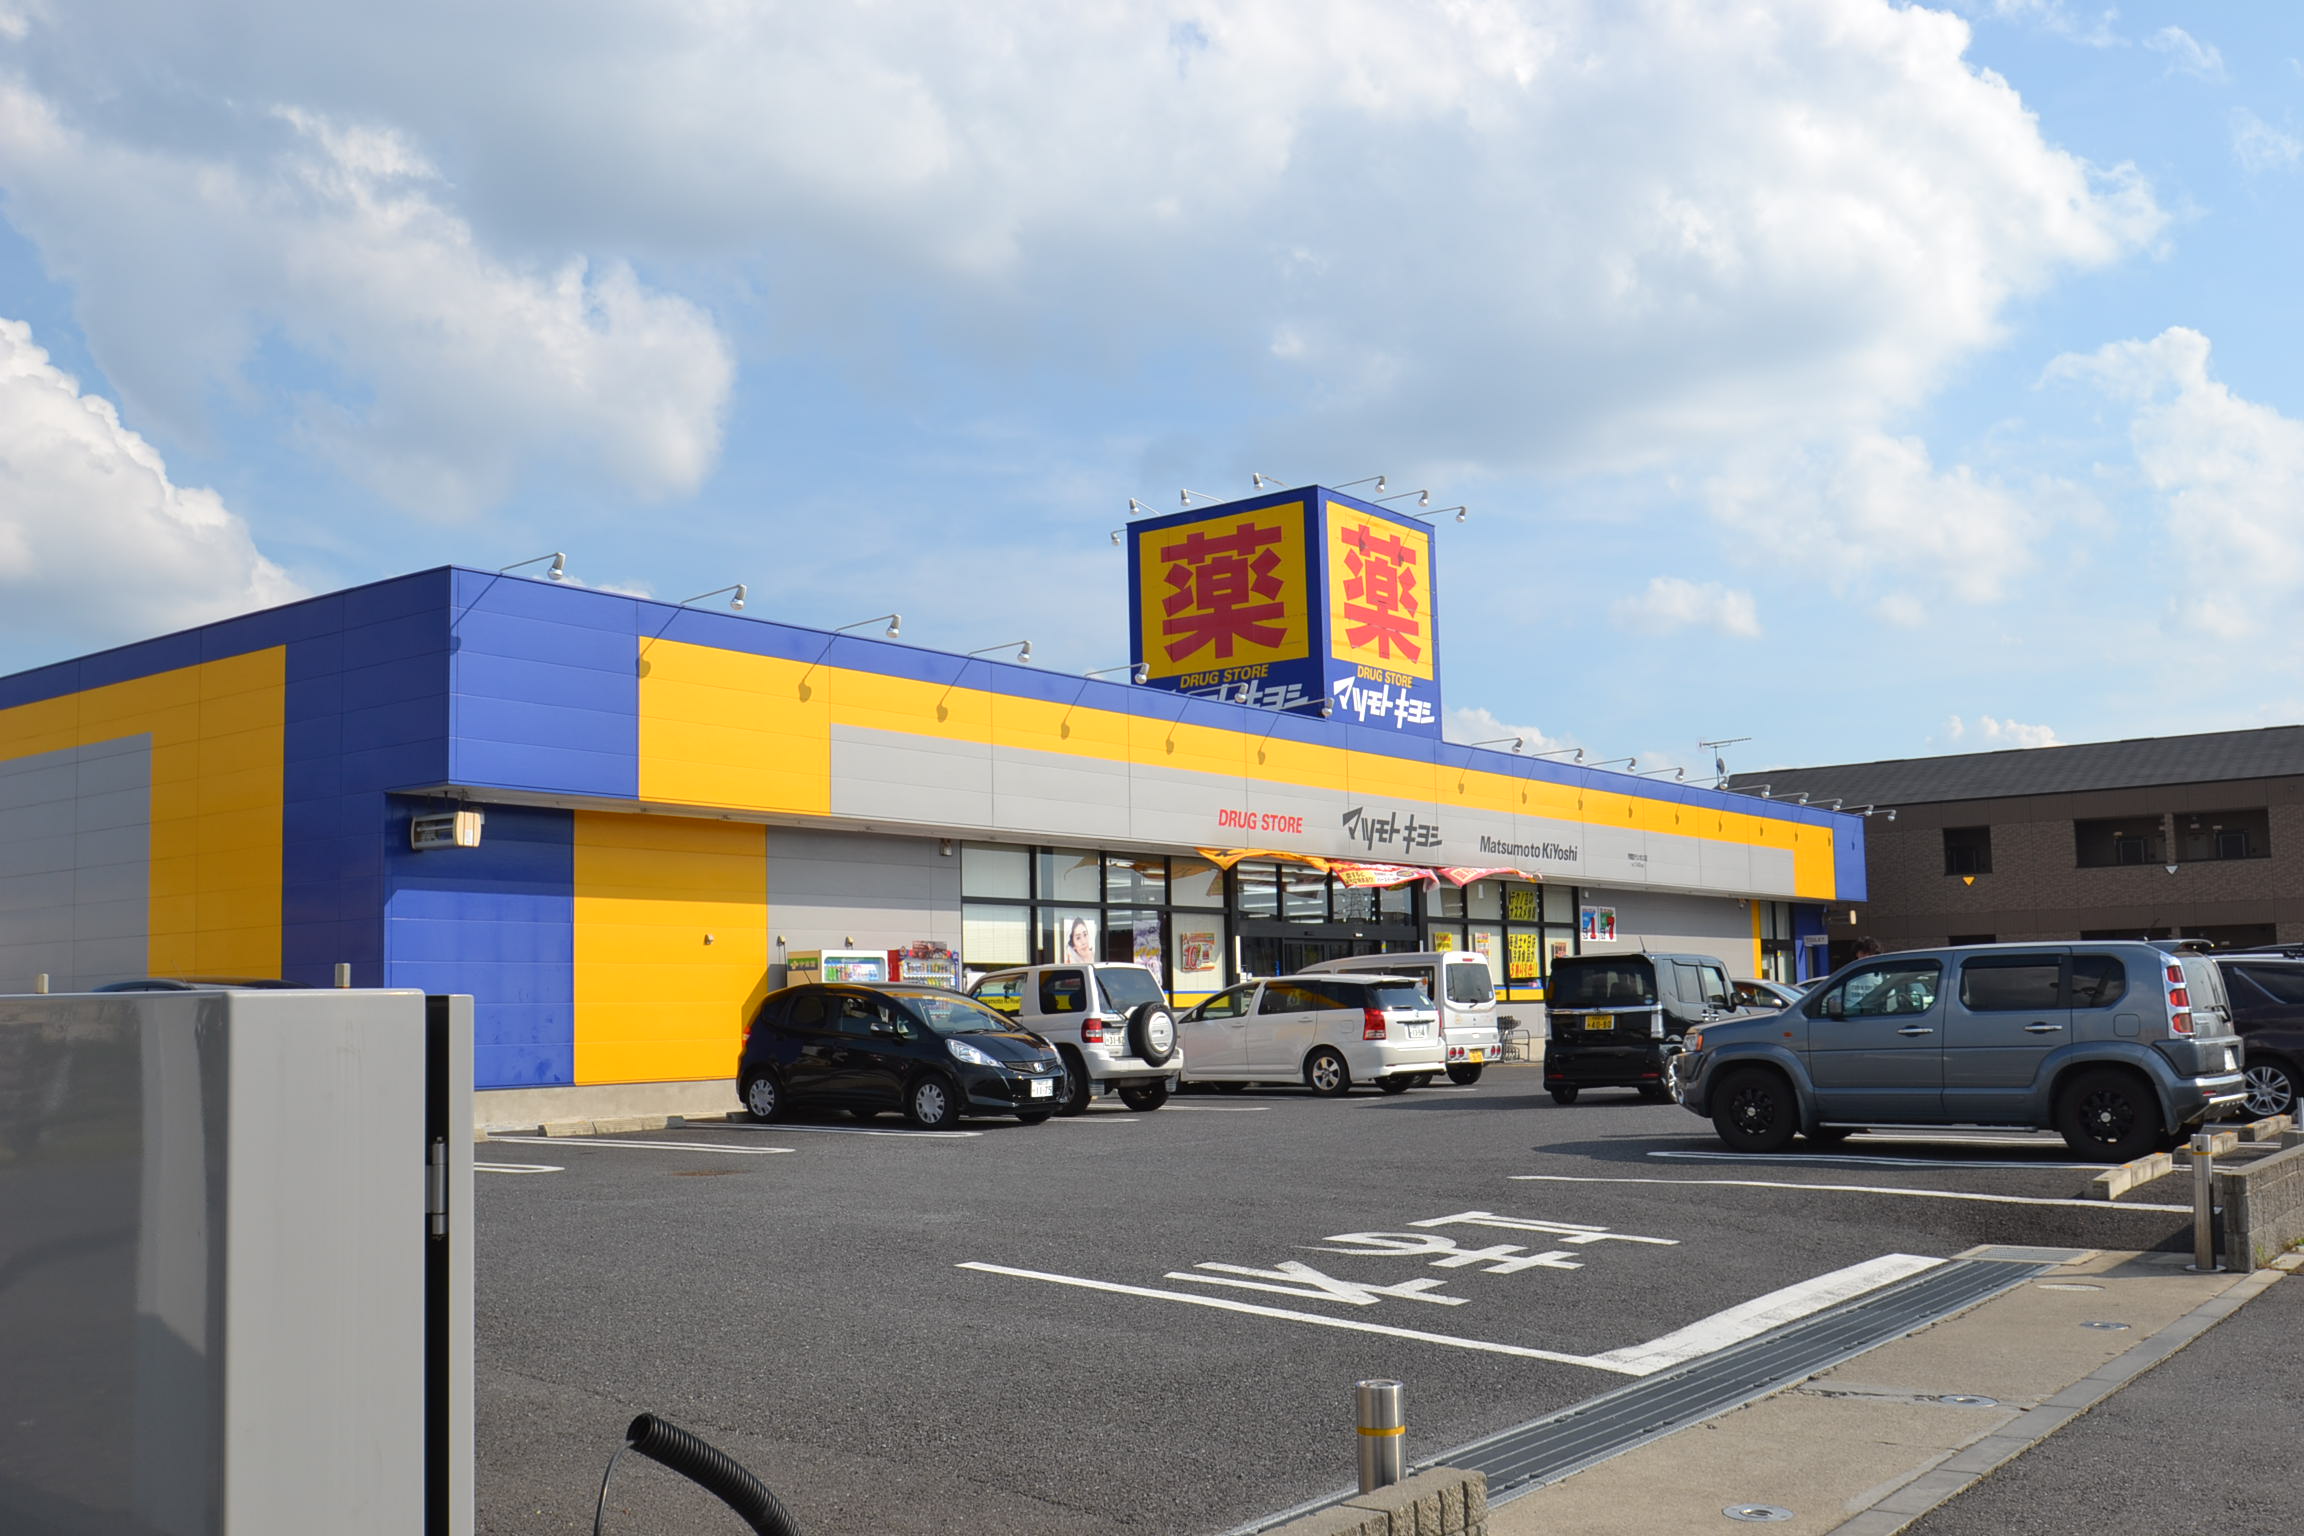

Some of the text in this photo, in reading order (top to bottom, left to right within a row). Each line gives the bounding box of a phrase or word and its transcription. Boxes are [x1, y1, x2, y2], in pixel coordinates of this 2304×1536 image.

[1161, 522, 1288, 663] 薬
[1341, 524, 1421, 664] 薬
[1180, 664, 1269, 689] DRUG STORE
[1357, 665, 1413, 689] DRUG STORE
[1333, 676, 1435, 729] マツモトキヨシ
[1218, 809, 1303, 834] DRUG STORE
[1342, 806, 1443, 855] マツモトキヨシ
[1479, 835, 1578, 862] Matsumoto KiYoshi
[1163, 1210, 1681, 1306] 止まれ
